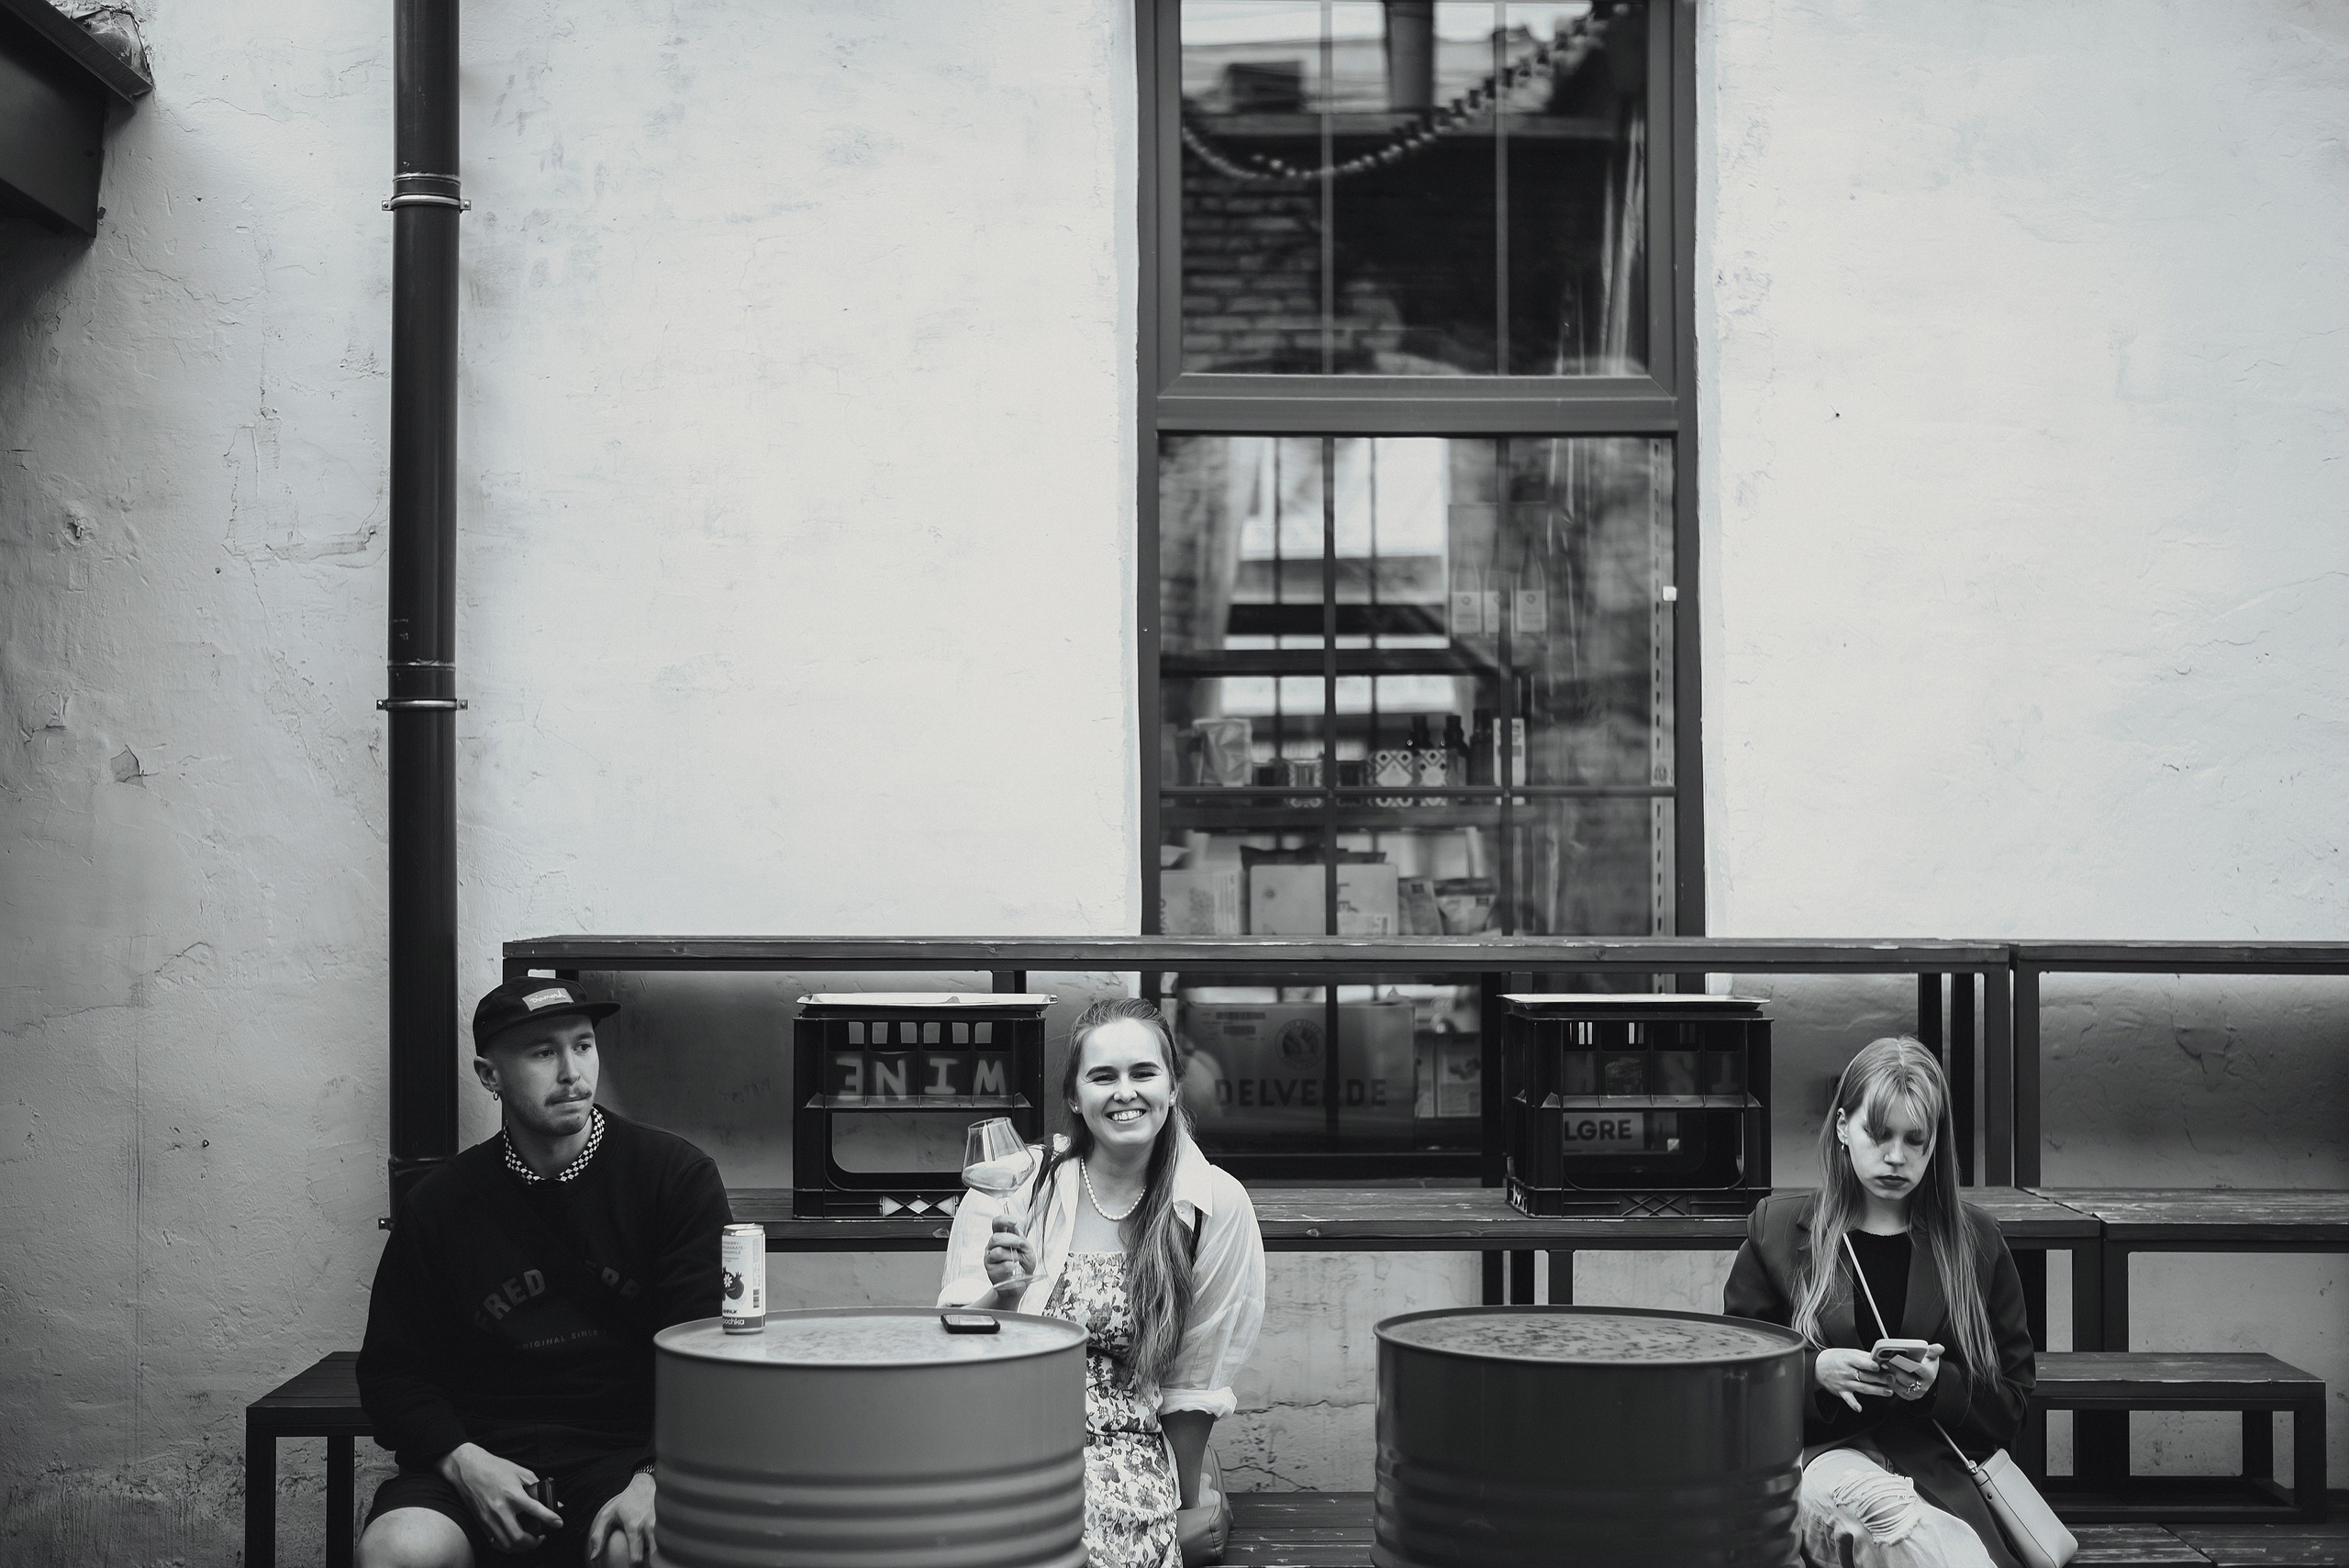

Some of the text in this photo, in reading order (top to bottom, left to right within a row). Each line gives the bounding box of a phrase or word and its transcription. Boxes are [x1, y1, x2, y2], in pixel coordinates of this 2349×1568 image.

[529, 989, 566, 1005] Diamond
[836, 1057, 1007, 1103] WINE
[473, 1268, 546, 1334] FRED
[515, 1335, 566, 1351] ORIGINAL
[571, 1329, 599, 1340] SINCE
